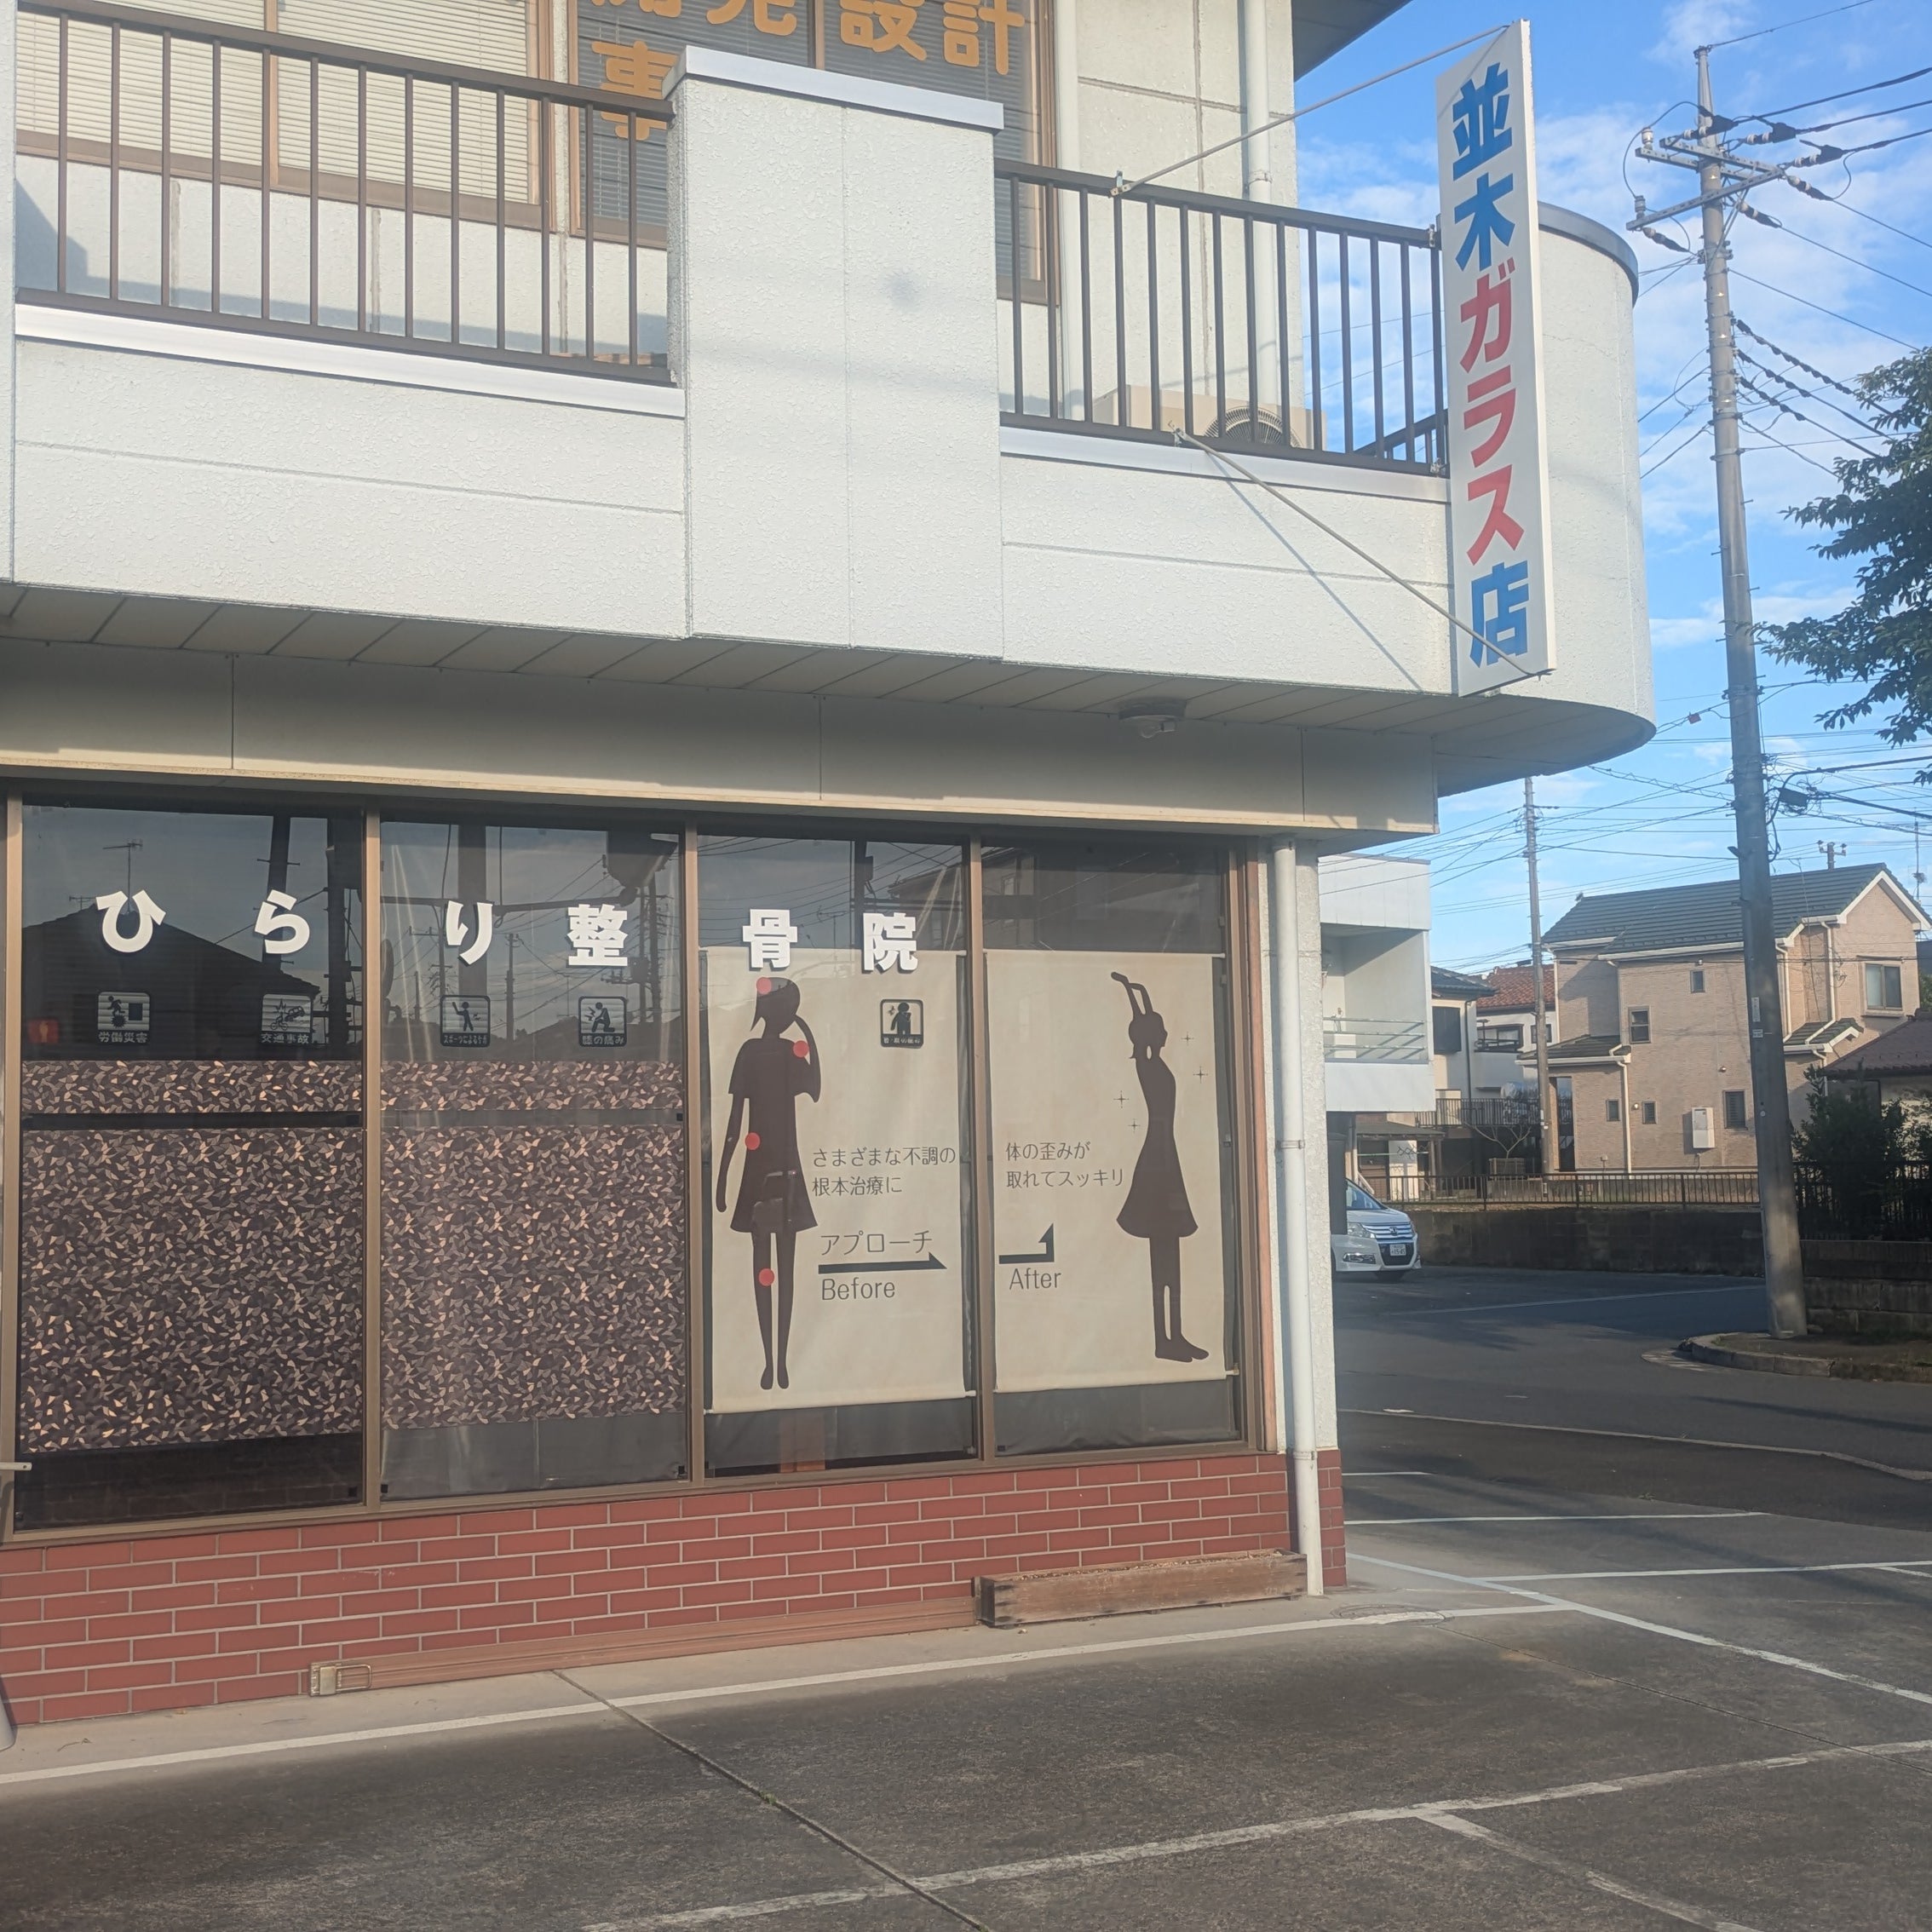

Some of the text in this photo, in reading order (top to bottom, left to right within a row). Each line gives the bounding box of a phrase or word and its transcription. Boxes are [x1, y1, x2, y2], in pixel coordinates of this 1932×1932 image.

[1452, 61, 1532, 668] 並木ガラス店
[95, 888, 919, 972] ひらり整骨院
[98, 1031, 148, 1044] 労働災害
[261, 1032, 309, 1044] 交通事故
[813, 1147, 956, 1168] さまざまな不調の
[1005, 1141, 1091, 1162] 体の歪みが
[812, 1176, 903, 1197] 根本治療に
[1006, 1169, 1124, 1189] 取れてスッキリ
[820, 1230, 933, 1256] アプローチ
[821, 1277, 895, 1301] Before
[1009, 1268, 1061, 1291] After
